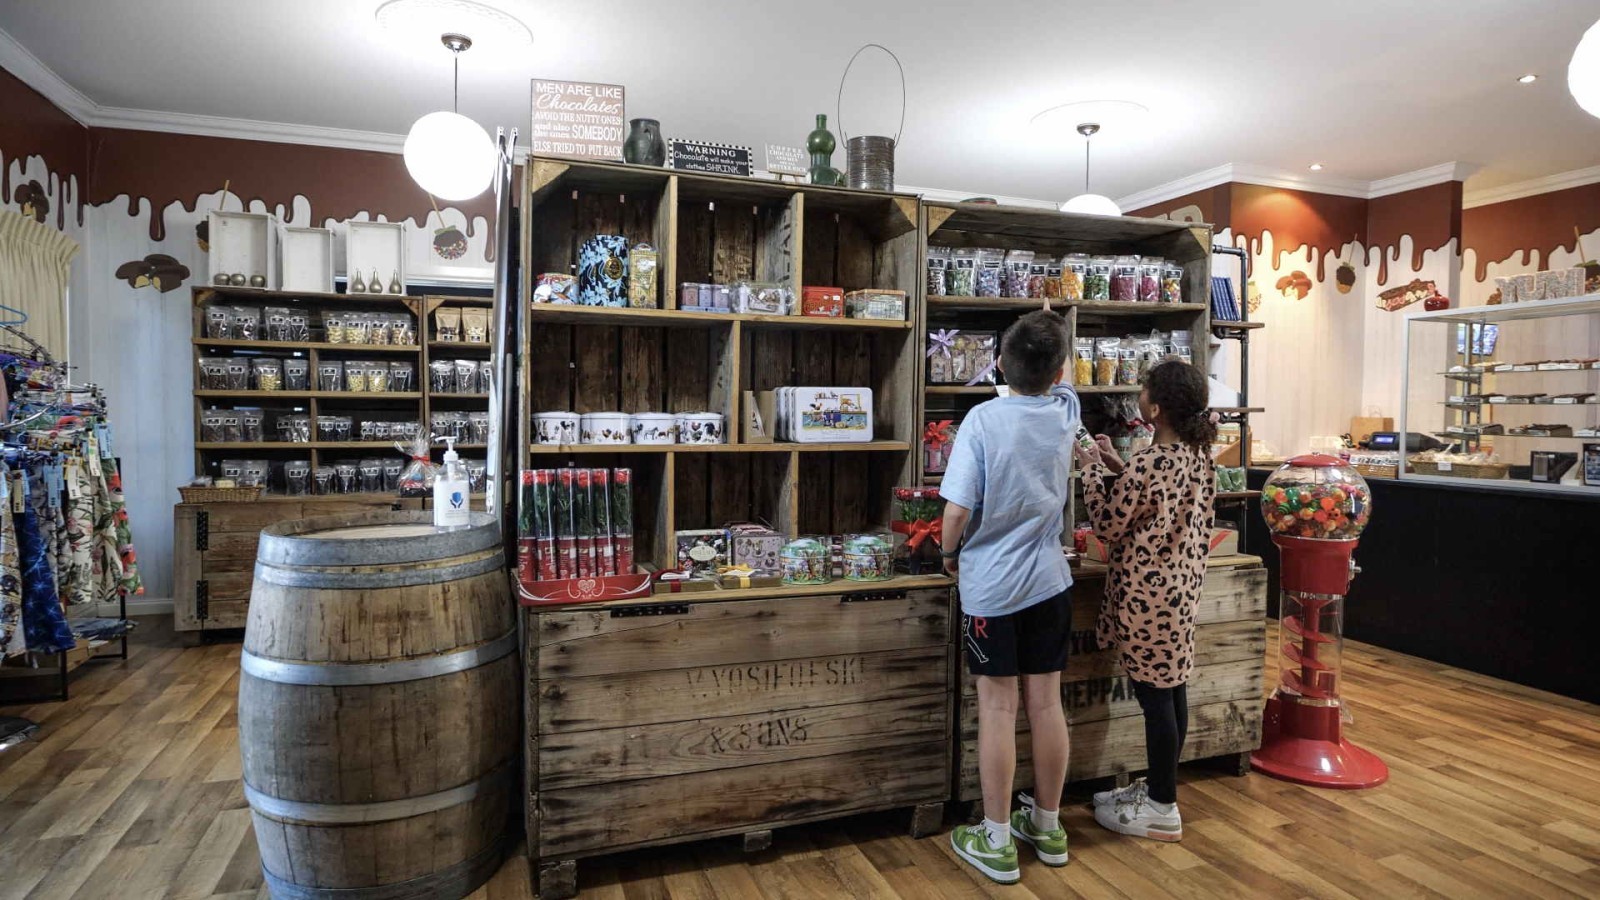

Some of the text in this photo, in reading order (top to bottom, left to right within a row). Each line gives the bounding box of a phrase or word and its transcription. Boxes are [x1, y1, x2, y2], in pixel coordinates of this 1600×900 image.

[536, 82, 622, 99] MEN ARE LIKE
[536, 93, 621, 114] Chocolates
[535, 111, 621, 126] AVOID THE NUTTY ONES
[572, 124, 622, 142] SOMEBODY
[534, 141, 622, 157] ELSE TRIED TO PUT BACK
[674, 151, 709, 162] Chocolate
[685, 144, 736, 158] WARNING
[1494, 268, 1586, 303] YUM
[975, 617, 988, 639] R
